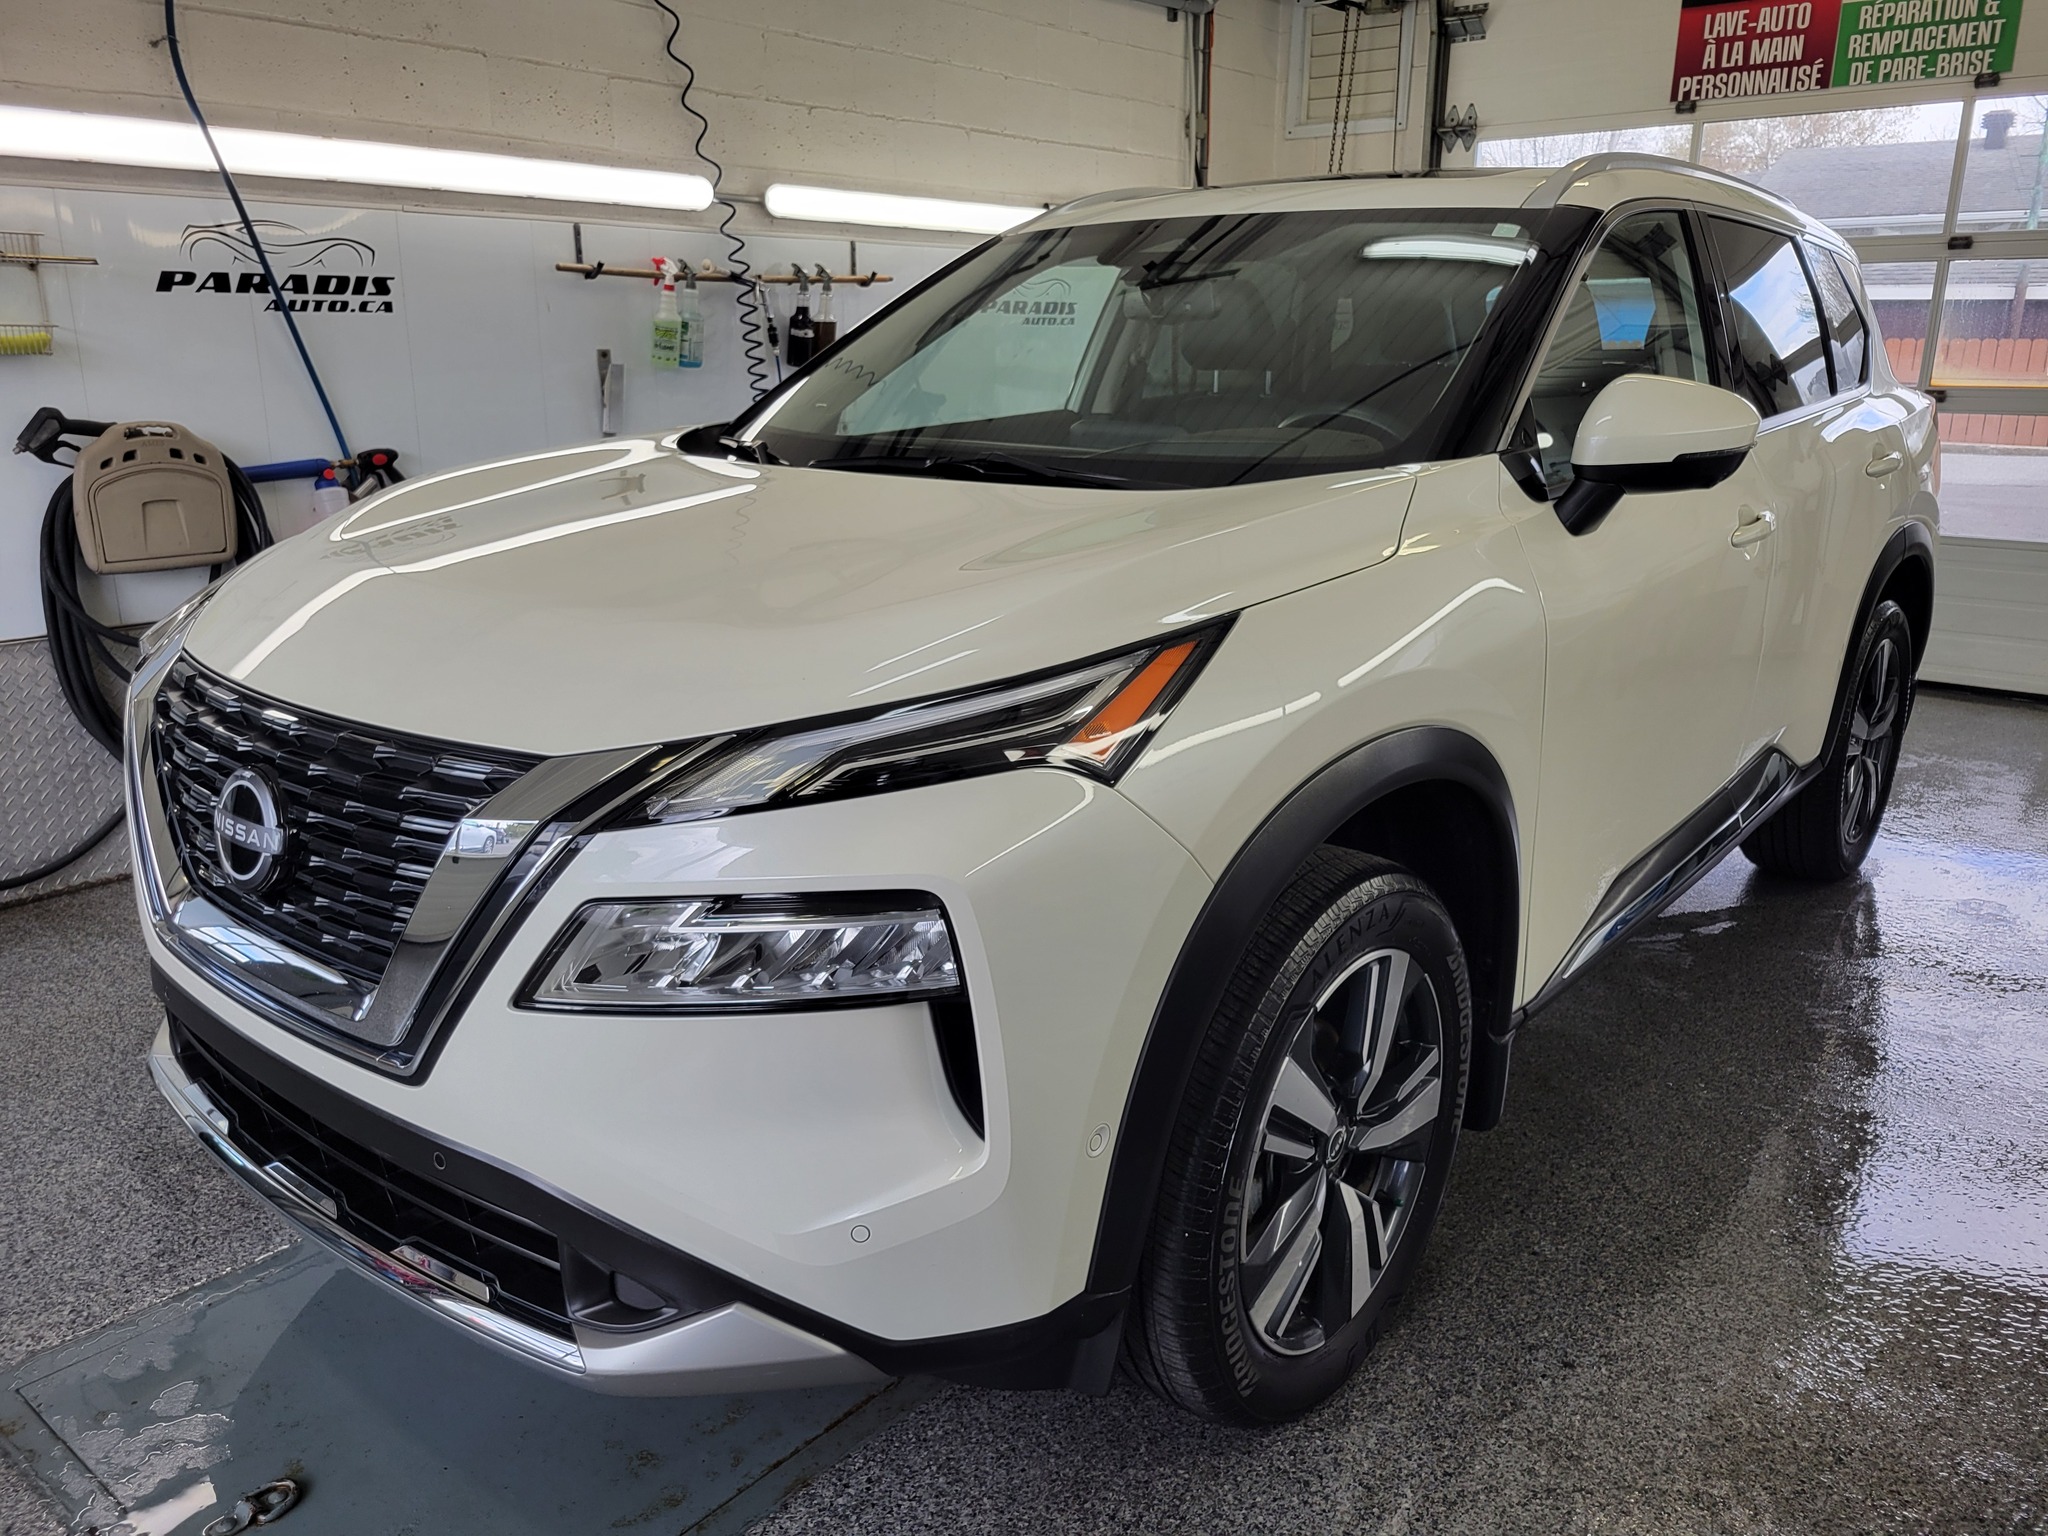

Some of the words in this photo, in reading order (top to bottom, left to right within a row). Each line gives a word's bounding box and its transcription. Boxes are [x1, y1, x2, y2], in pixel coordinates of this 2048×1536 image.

[1703, 2, 1812, 40] LAVE-AUTO
[1847, 19, 2006, 59] REMPLACEMENT
[1702, 39, 1716, 70] À
[1721, 41, 1744, 68] LA
[1749, 35, 1805, 65] MAIN
[1849, 60, 1875, 86] DE
[1878, 49, 1996, 83] PARE-BRISE
[1677, 58, 1824, 101] PERSONNALISÉ
[156, 271, 396, 297] PARADIS
[263, 299, 395, 314] AUTO.CA
[981, 300, 1078, 316] PARADIS
[1022, 317, 1075, 327] AUTO.CA
[214, 809, 278, 853] NISSAN
